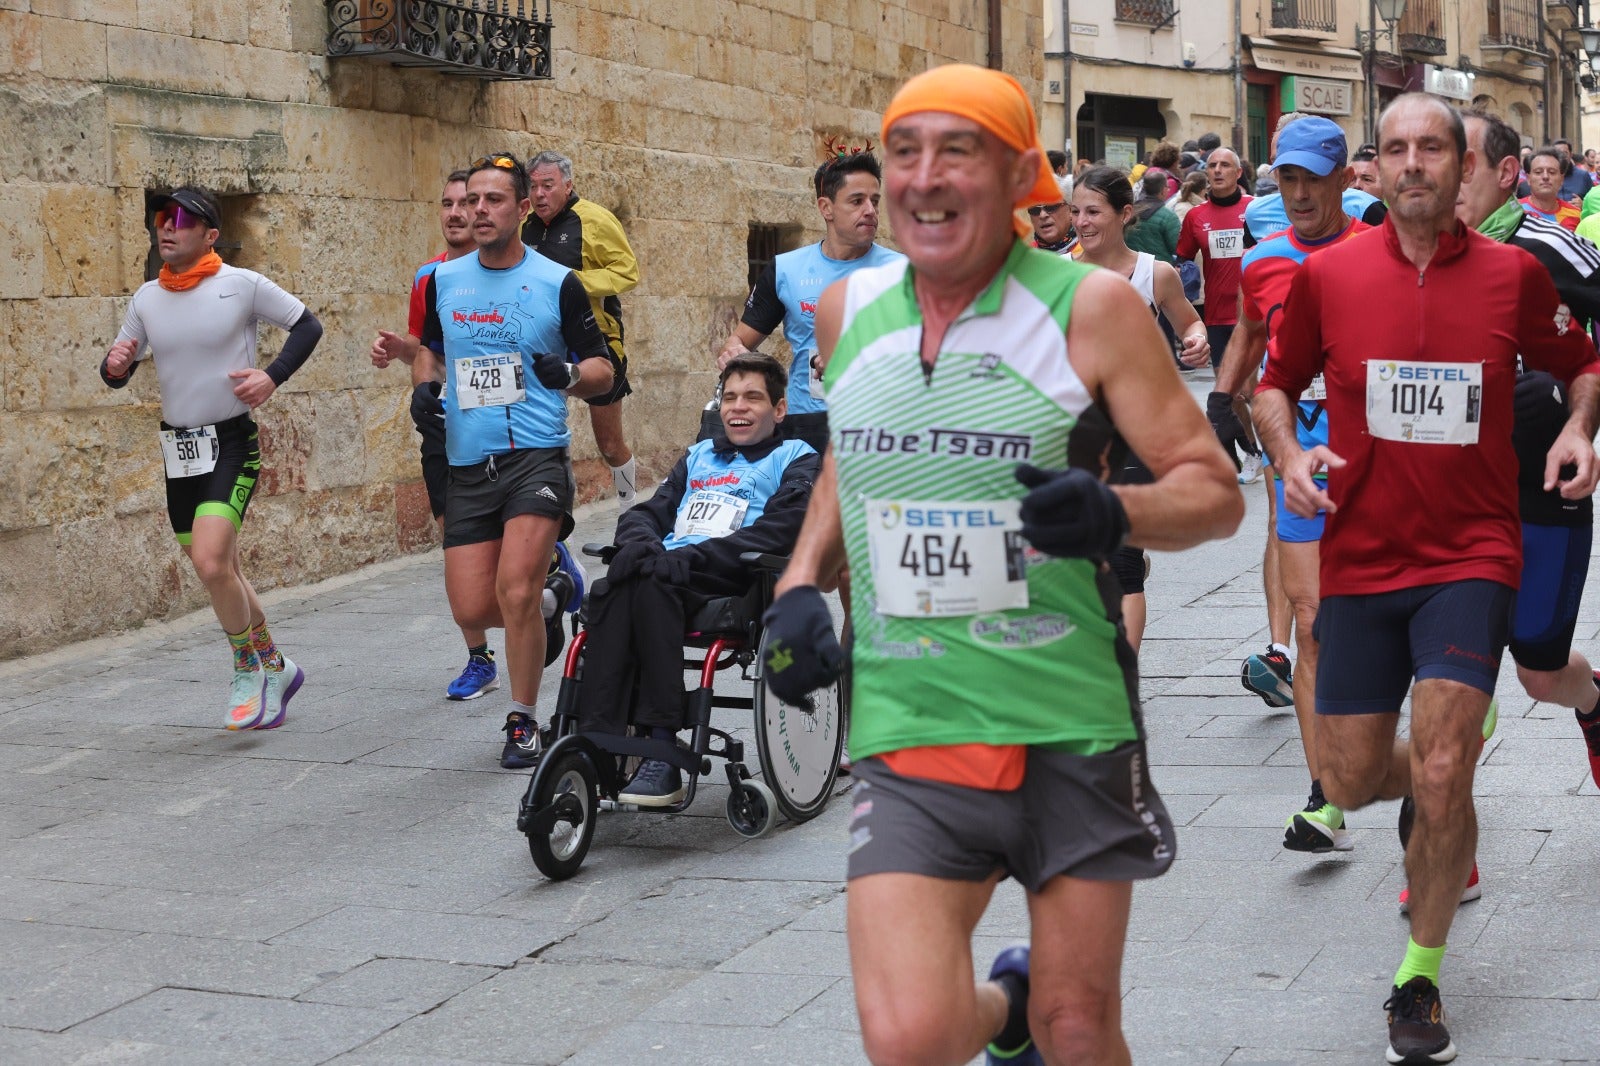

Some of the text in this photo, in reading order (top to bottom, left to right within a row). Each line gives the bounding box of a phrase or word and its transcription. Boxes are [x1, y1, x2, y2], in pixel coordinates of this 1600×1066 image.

[1302, 86, 1343, 110] SCALE
[1216, 237, 1236, 249] 1627
[475, 327, 517, 341] FLOWERS
[472, 356, 515, 369] SETEL
[470, 368, 501, 390] 428
[1398, 366, 1471, 382] SETEL
[1391, 383, 1445, 416] 1014
[177, 440, 200, 460] 581
[695, 492, 741, 509] SETEL
[687, 502, 721, 520] 1217
[905, 508, 1006, 528] SETEL
[899, 533, 972, 577] 464
